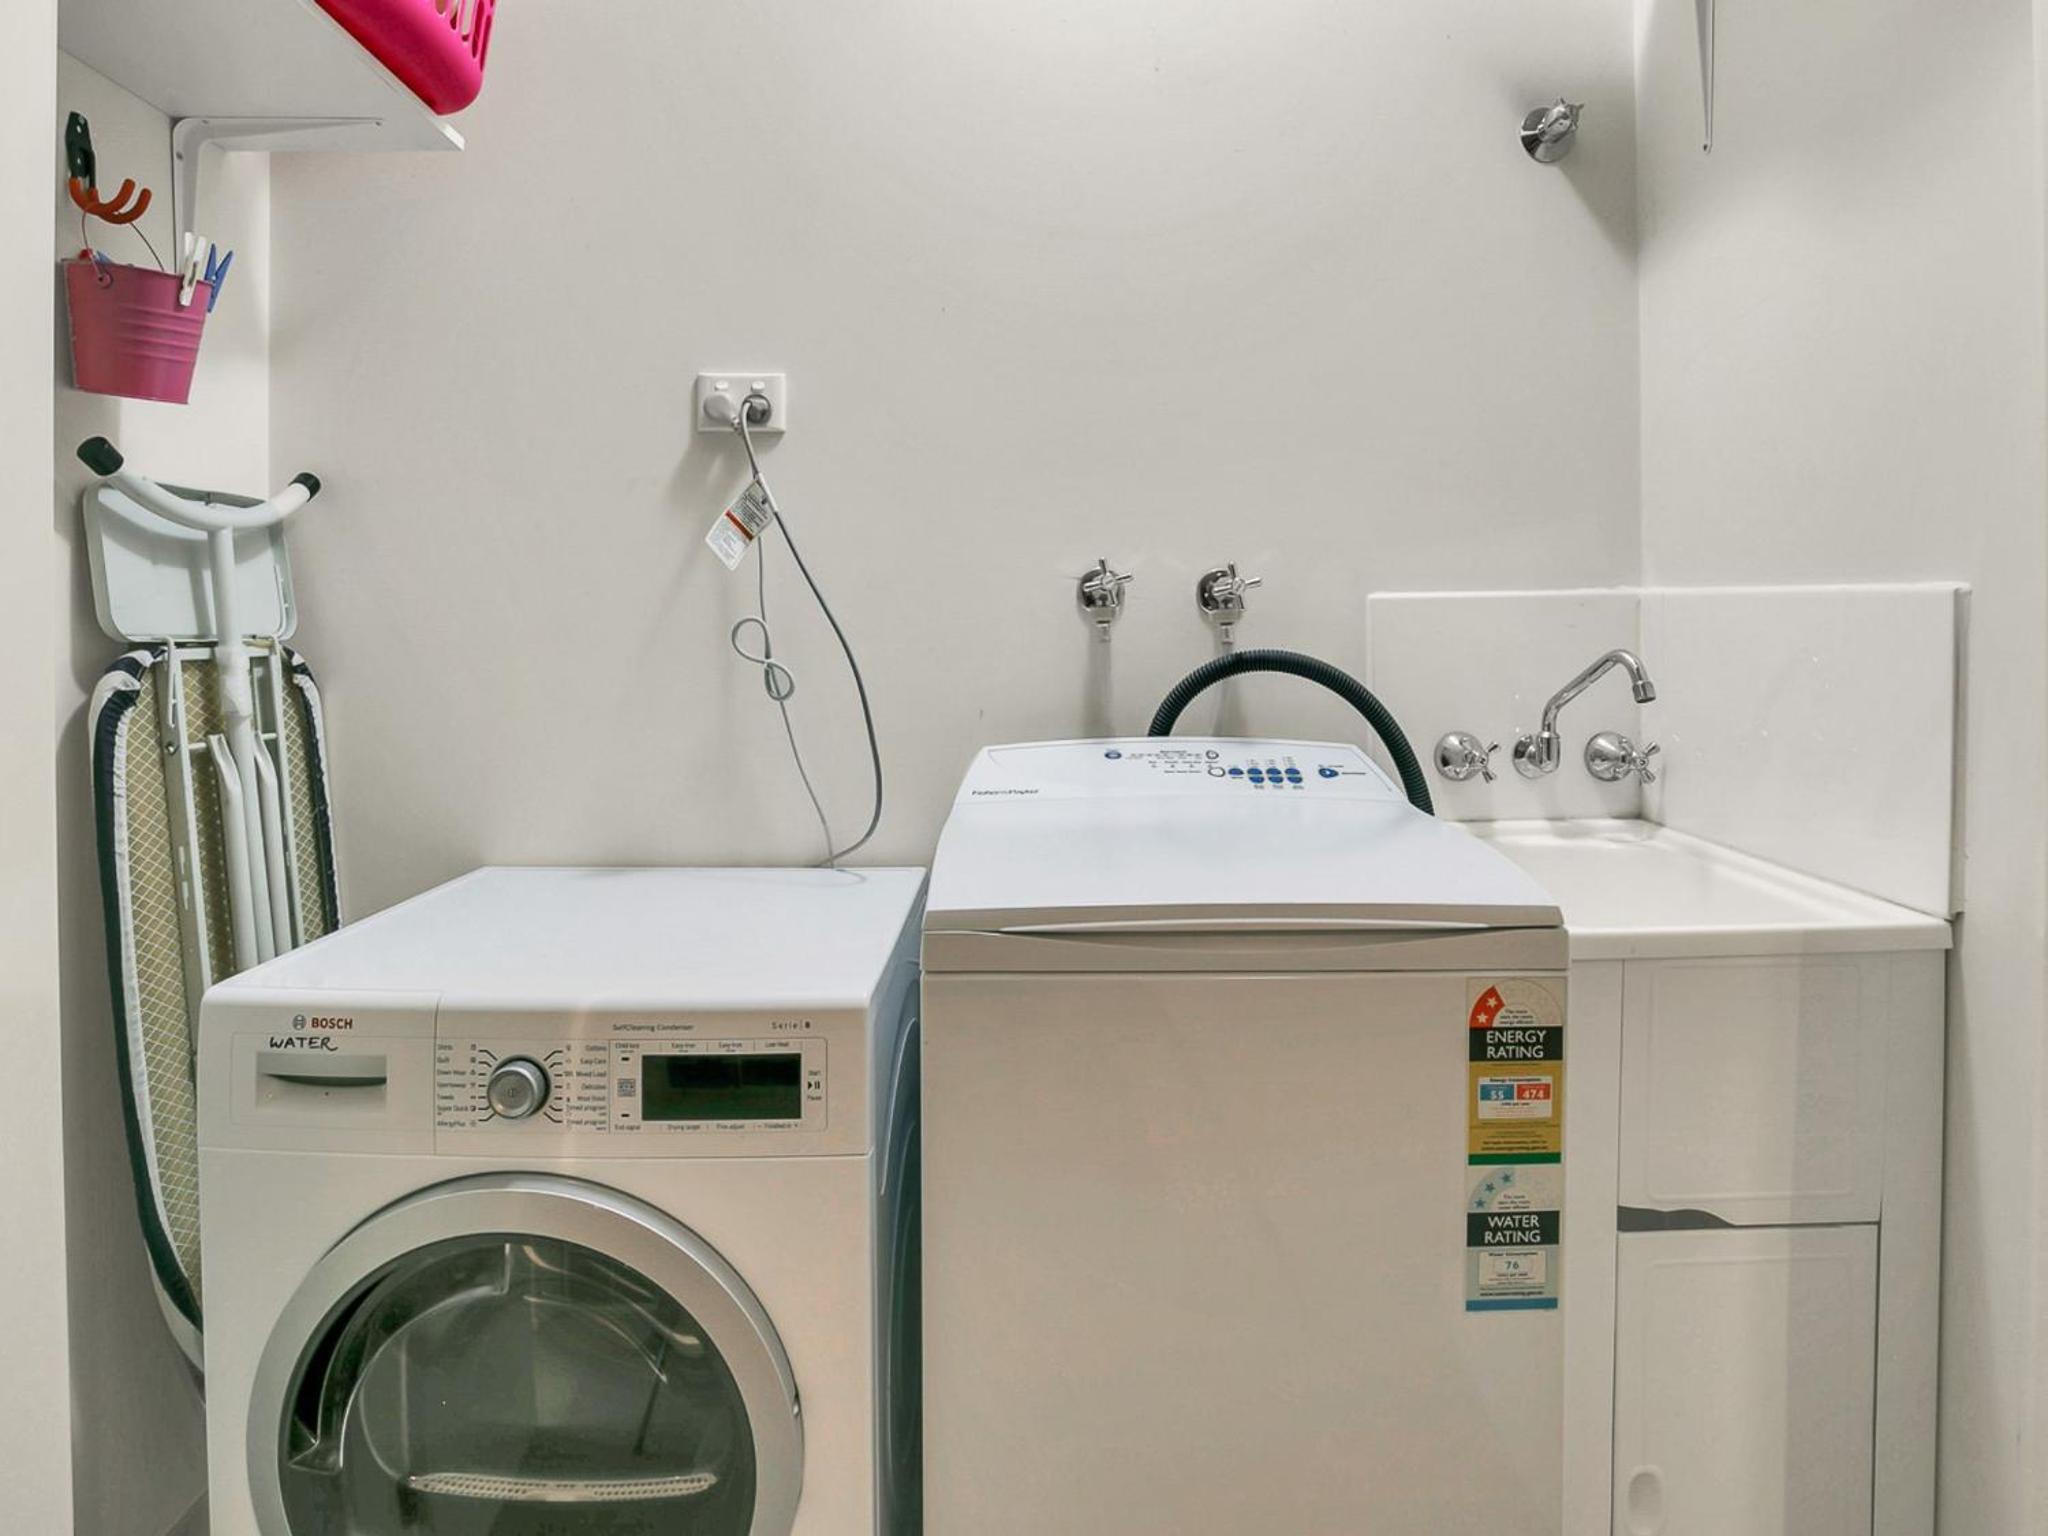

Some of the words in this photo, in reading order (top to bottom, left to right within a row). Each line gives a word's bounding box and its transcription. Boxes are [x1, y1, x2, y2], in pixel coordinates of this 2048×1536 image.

[311, 1017, 353, 1030] BOSCH
[771, 1021, 798, 1030] Serie
[269, 1036, 339, 1052] WATER
[1486, 1029, 1547, 1044] ENERGY
[1486, 1044, 1545, 1060] RATING
[1522, 1088, 1545, 1099] 474
[1487, 1214, 1540, 1229] WATER
[1484, 1230, 1542, 1245] RATING
[1504, 1260, 1520, 1270] 76
